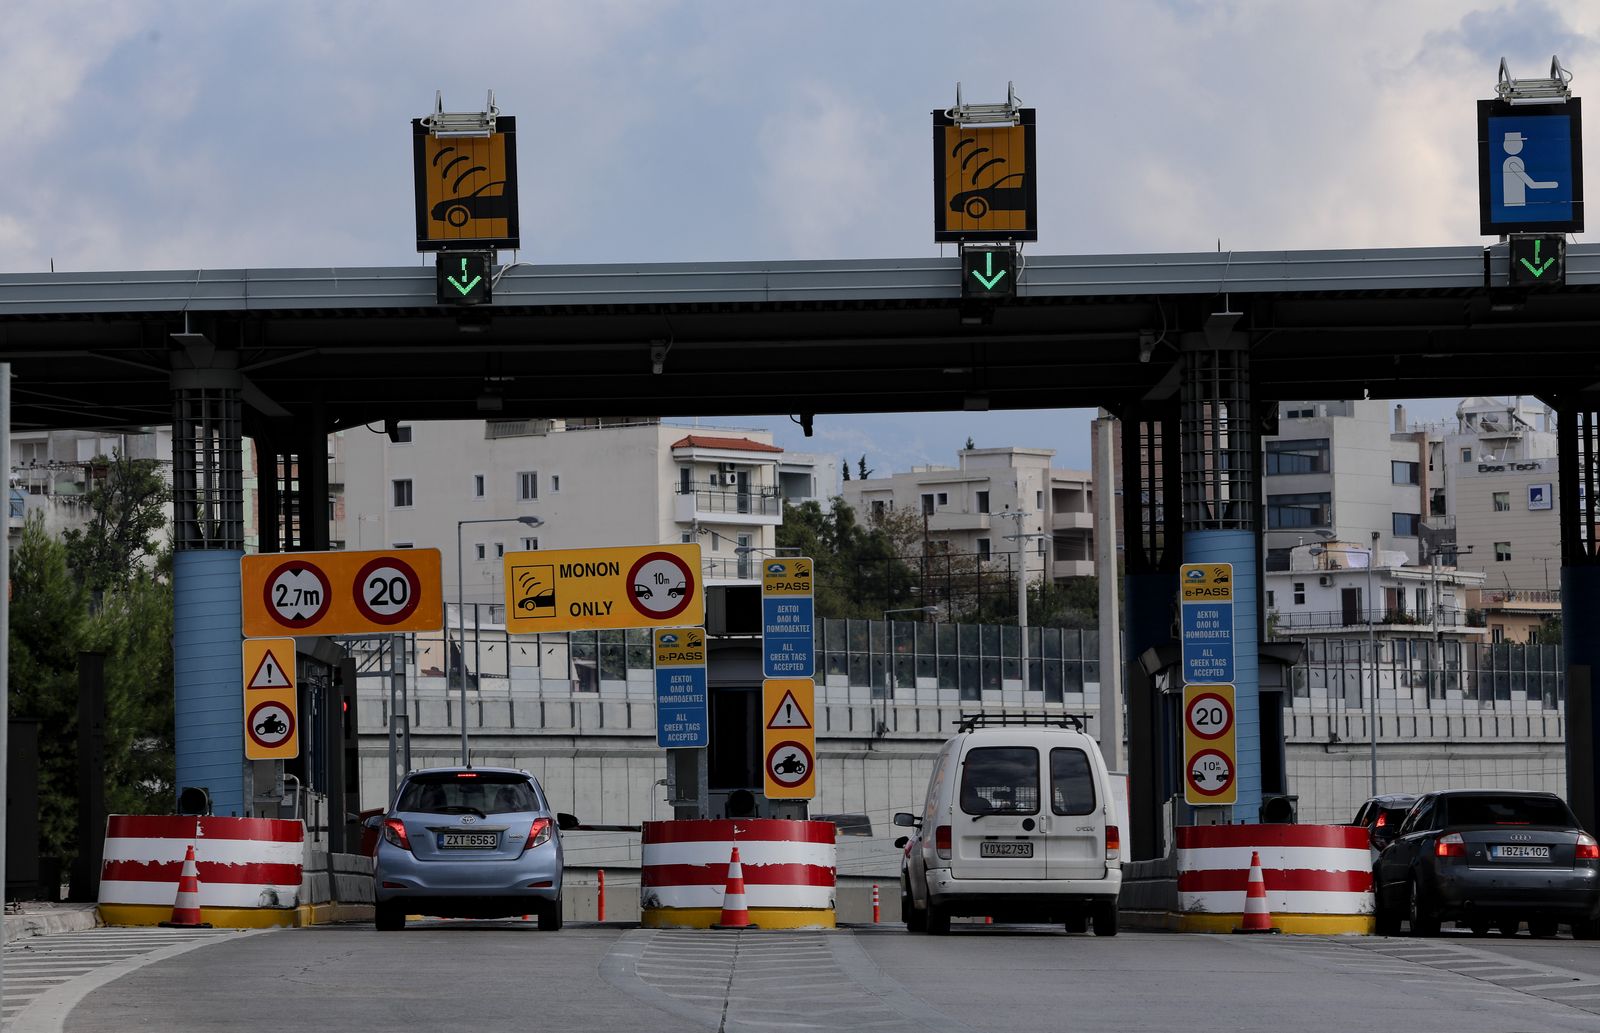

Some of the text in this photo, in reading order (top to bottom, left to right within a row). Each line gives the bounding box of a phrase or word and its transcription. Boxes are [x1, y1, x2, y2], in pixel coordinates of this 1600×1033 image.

[1478, 462, 1541, 472] Bee Tech
[370, 576, 408, 605] 20
[766, 582, 810, 591] e-PASS
[275, 584, 320, 607] 2.7m
[1185, 588, 1229, 596] e-PASS
[570, 601, 612, 616] ONLY
[659, 652, 702, 661] e-PASS
[1194, 669, 1224, 677] ACCEPTED
[1196, 708, 1222, 725] 20
